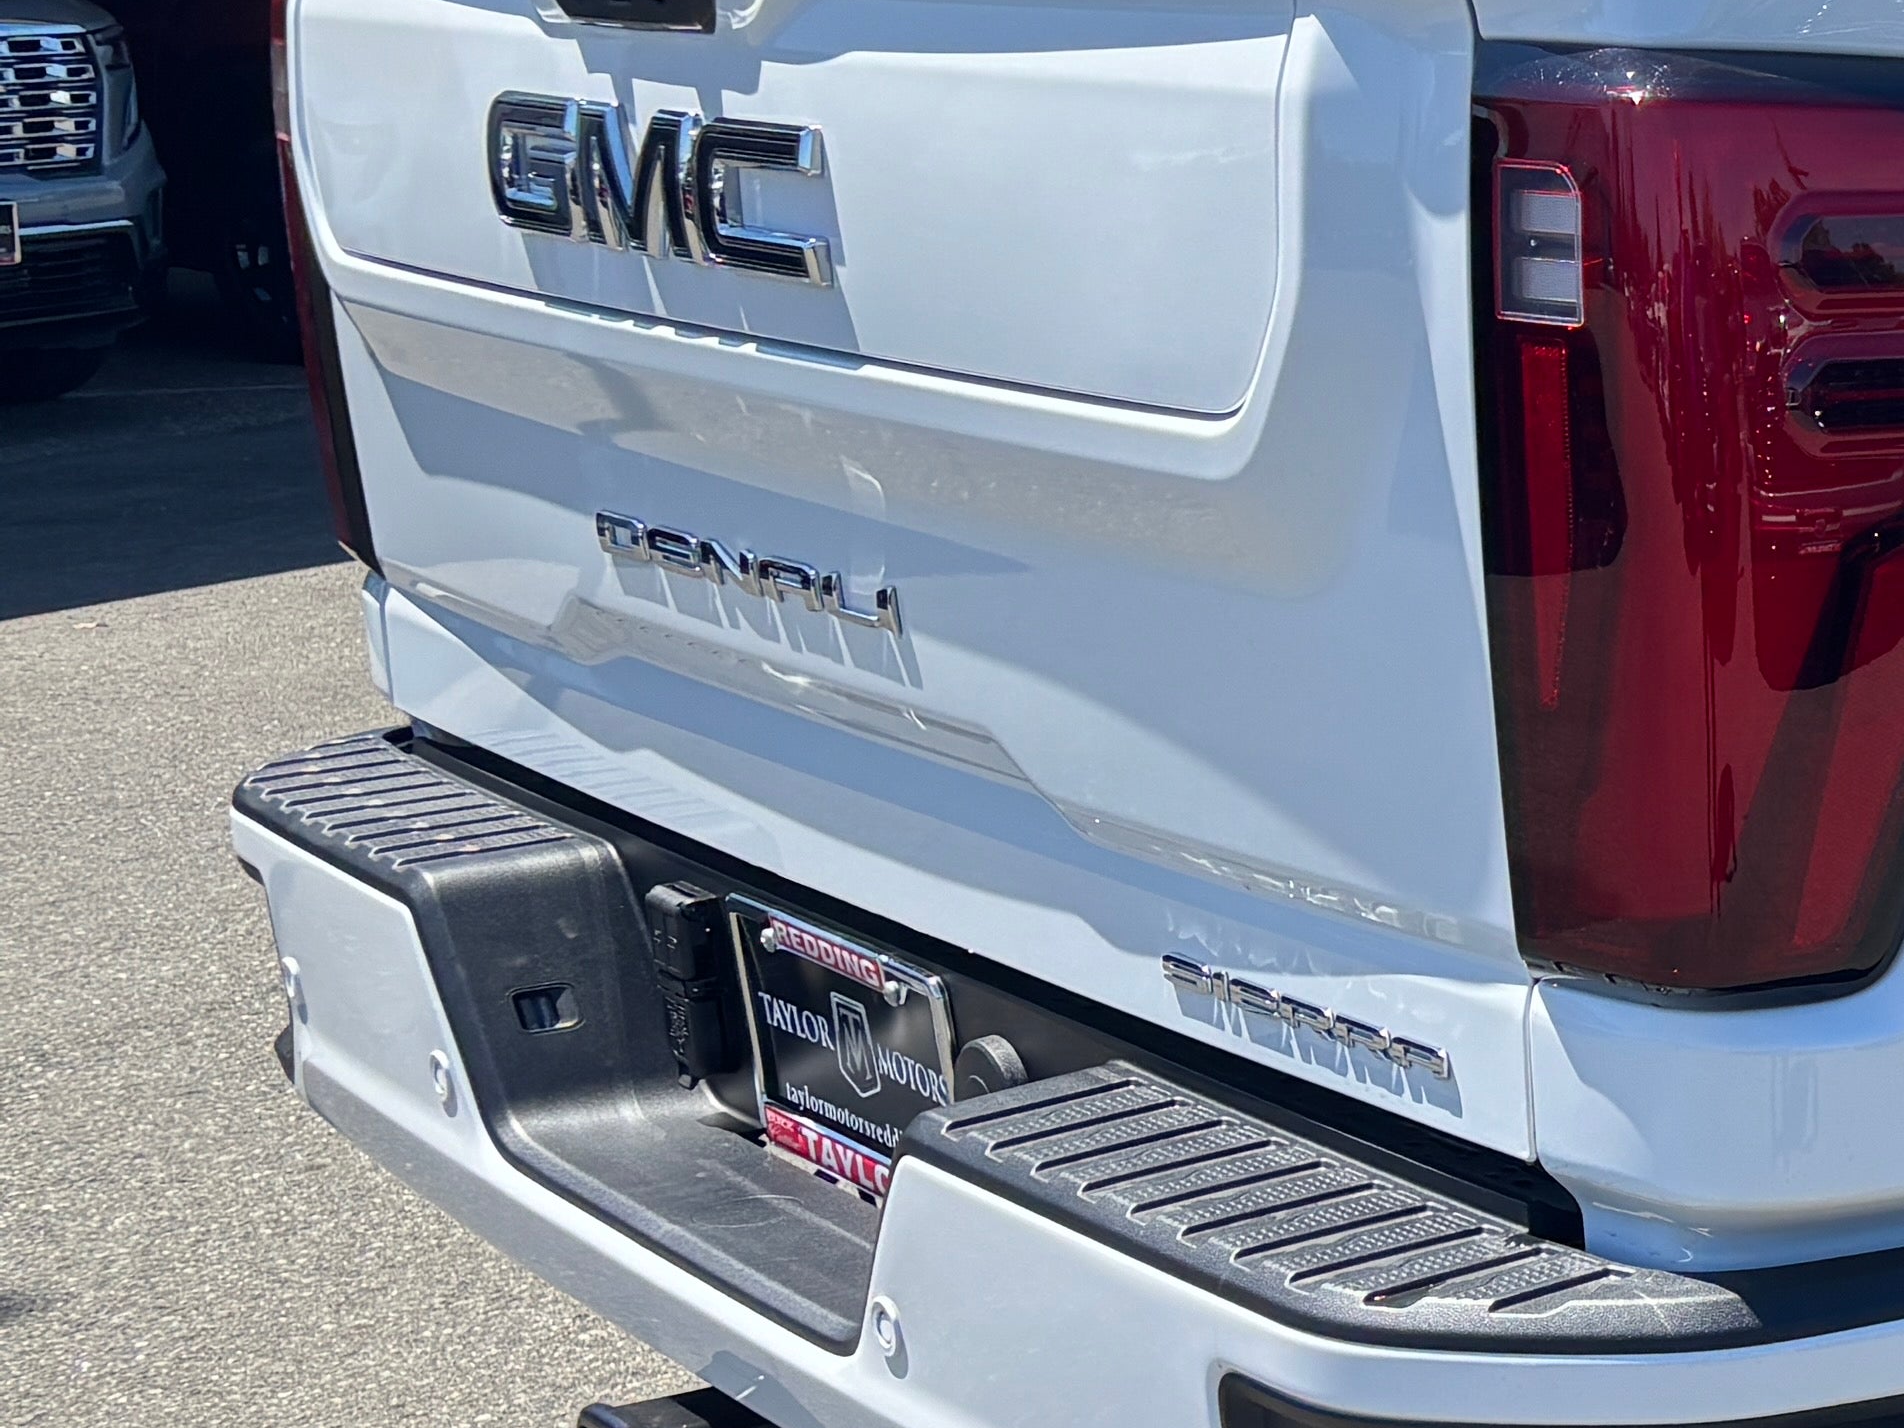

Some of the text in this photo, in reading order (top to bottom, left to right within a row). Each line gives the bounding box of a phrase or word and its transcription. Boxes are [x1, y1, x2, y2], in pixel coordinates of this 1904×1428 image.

[487, 89, 834, 289] GMC
[595, 510, 904, 640] DENALI
[772, 919, 879, 989] REDDING
[758, 991, 836, 1052] TAYLOR
[876, 1045, 949, 1108] MOTORS
